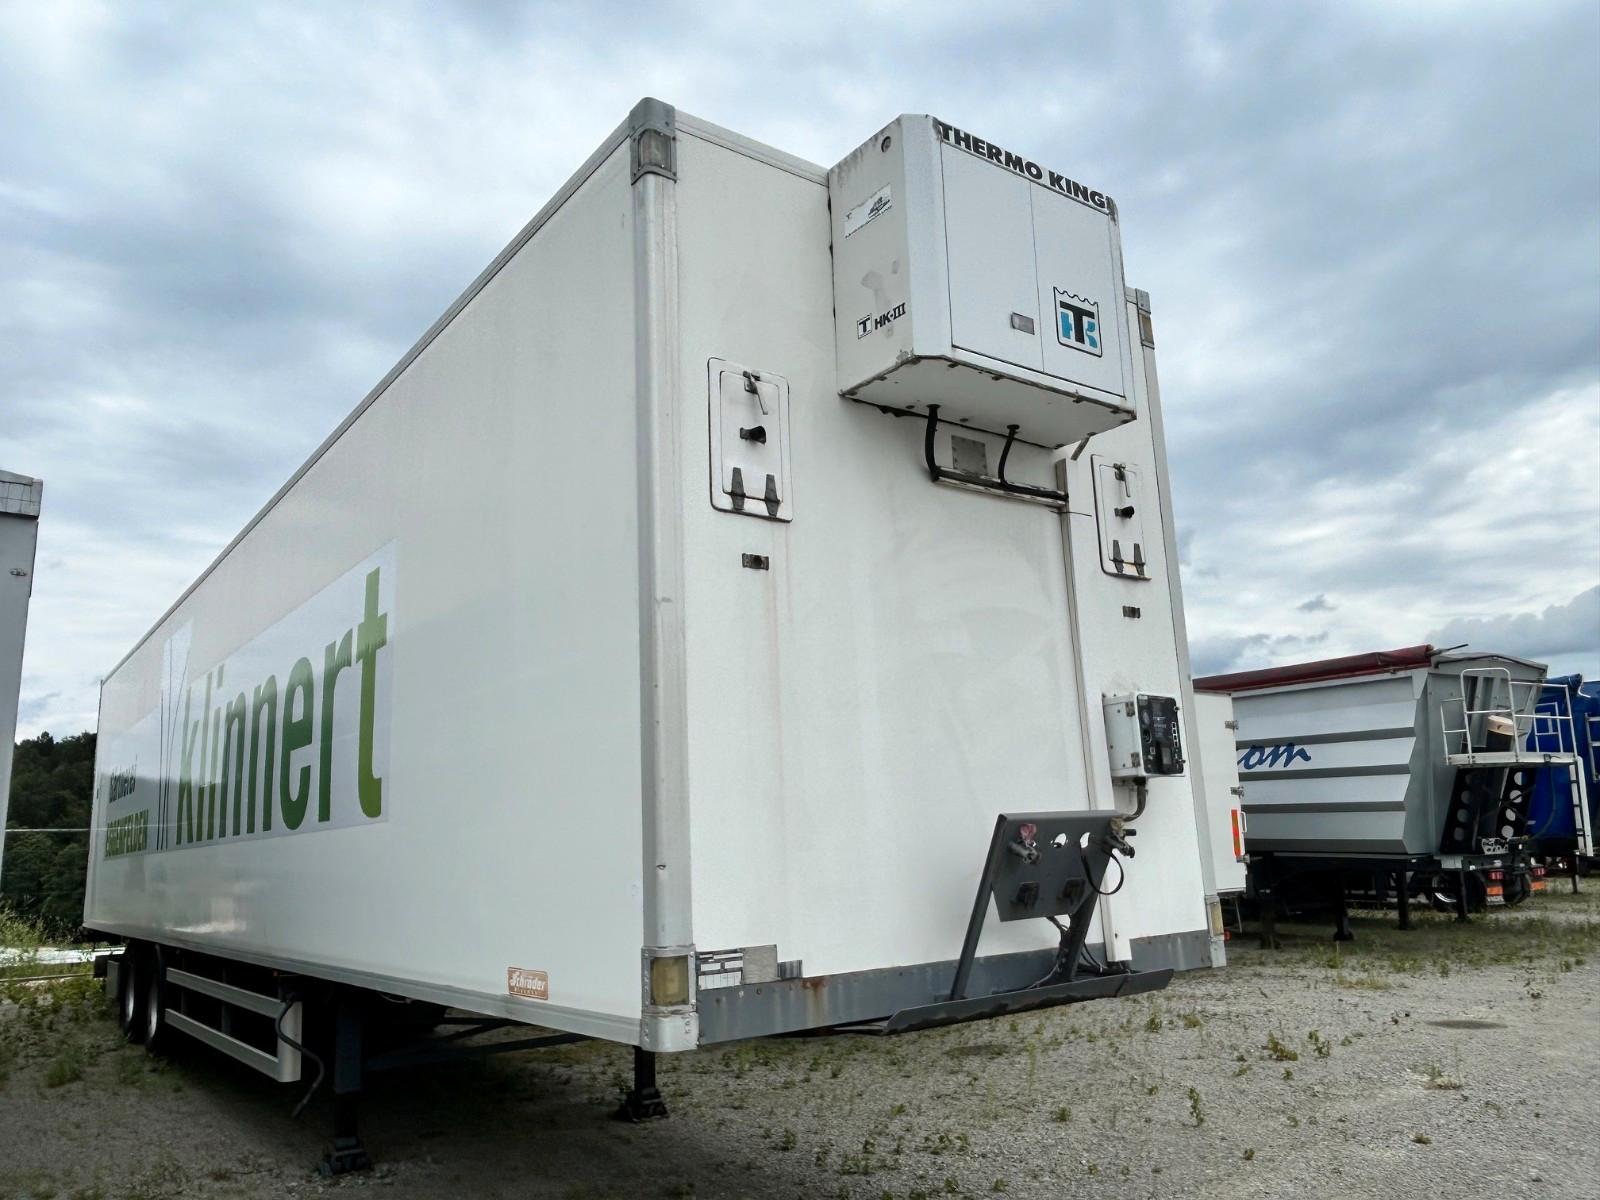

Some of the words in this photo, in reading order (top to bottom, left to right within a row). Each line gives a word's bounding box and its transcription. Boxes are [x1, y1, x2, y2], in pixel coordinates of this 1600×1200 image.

[939, 122, 1043, 180] THERMO
[1048, 170, 1106, 209] KING
[176, 566, 387, 845] klinnert
